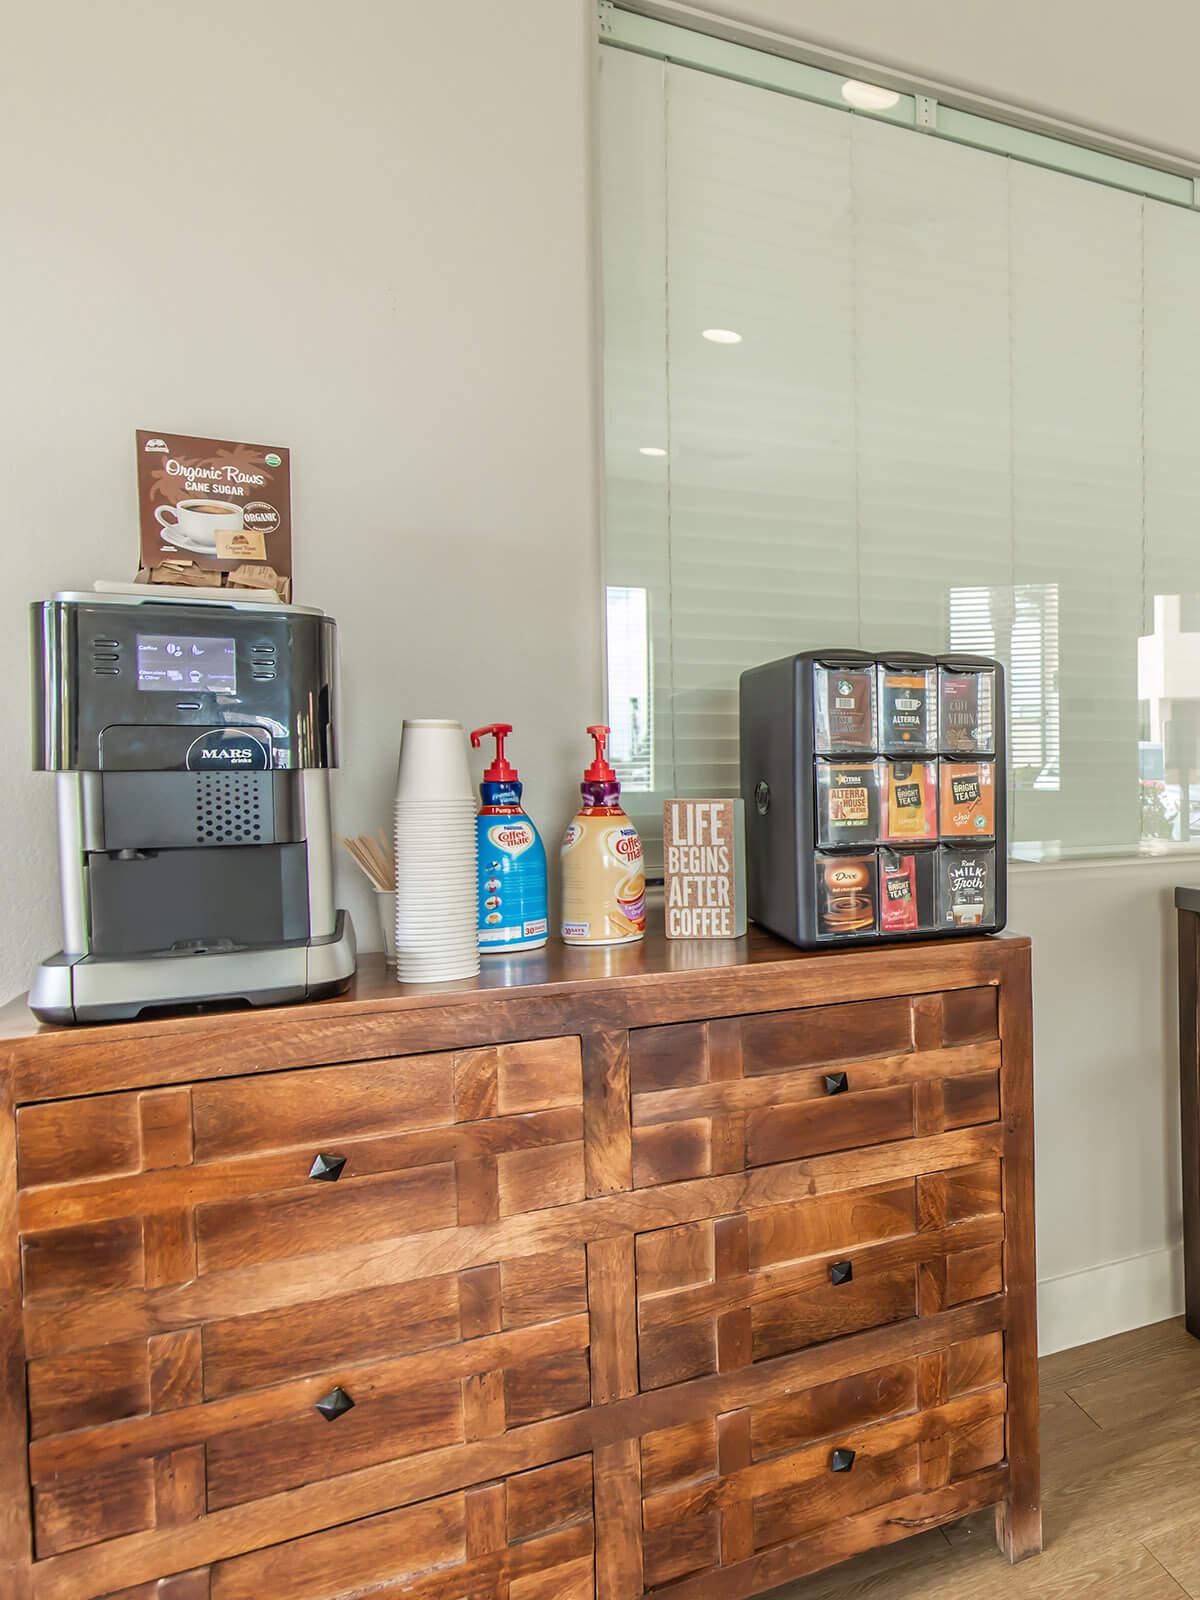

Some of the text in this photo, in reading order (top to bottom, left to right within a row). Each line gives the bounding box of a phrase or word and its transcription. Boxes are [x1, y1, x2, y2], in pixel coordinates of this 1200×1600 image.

[165, 459, 265, 486] Organic Raws
[184, 481, 244, 497] CANE SUGAR
[243, 512, 278, 523] ORGANIC
[893, 715, 921, 725] ALTERRA
[201, 749, 253, 759] MARS
[953, 782, 978, 793] BRIGHT
[831, 789, 865, 799] ALTERRA
[955, 792, 970, 801] TEA
[843, 799, 866, 808] HOUSE
[671, 803, 725, 846] LIFE
[498, 831, 527, 843] Coffee
[615, 836, 641, 855] Coffe
[627, 848, 641, 862] ma
[668, 846, 730, 874] BEGINS
[954, 866, 983, 878] MILK
[888, 880, 909, 892] BRIGHT
[951, 877, 985, 892] Froth
[668, 876, 731, 908] AFTER
[669, 907, 732, 937] COFFEE
[524, 927, 535, 936] 30
